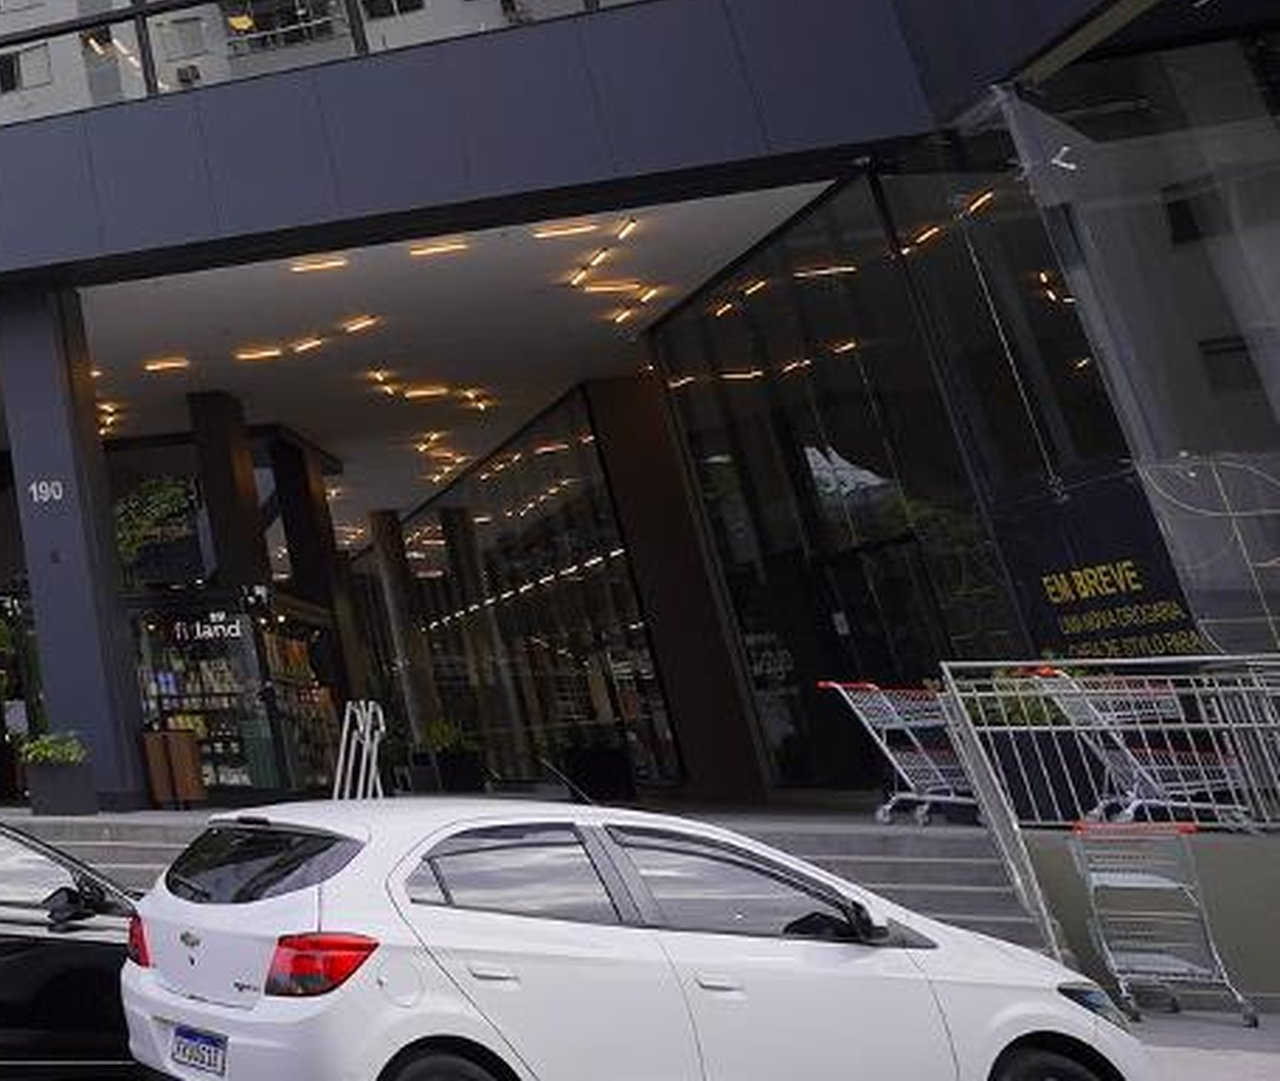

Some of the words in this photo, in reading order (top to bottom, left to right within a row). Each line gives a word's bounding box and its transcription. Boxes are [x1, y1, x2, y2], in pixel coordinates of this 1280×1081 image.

[29, 480, 63, 502] 190
[1071, 560, 1143, 600] BREVE
[174, 619, 241, 640] filand
